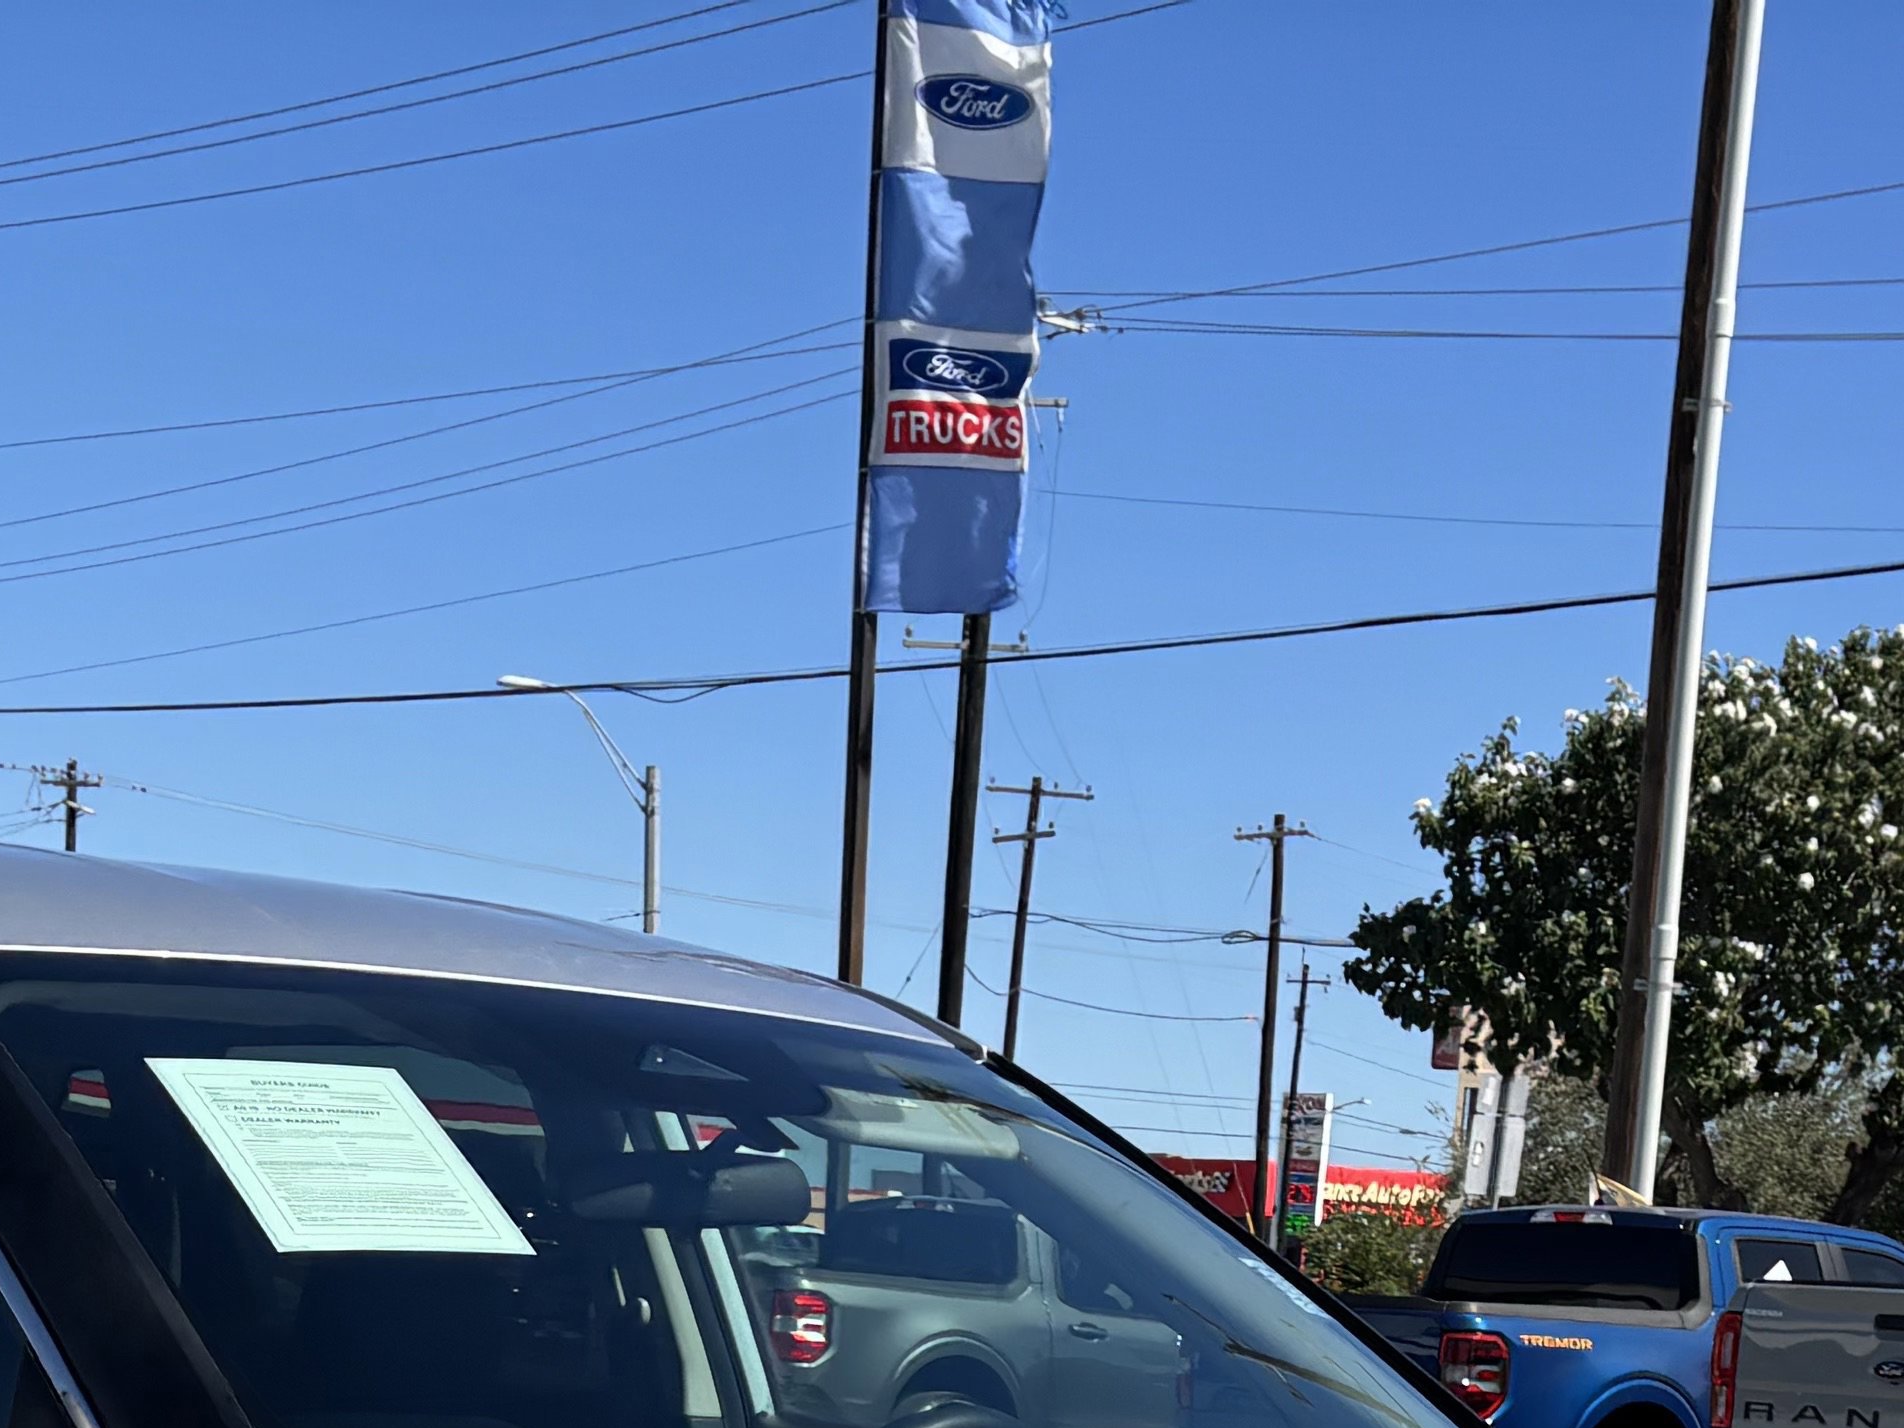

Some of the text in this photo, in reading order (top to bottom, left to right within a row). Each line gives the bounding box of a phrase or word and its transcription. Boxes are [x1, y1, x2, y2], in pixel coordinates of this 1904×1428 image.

[941, 82, 1007, 119] Ford
[926, 353, 988, 386] Ford
[892, 410, 1022, 450] TRUCKS
[1519, 1334, 1594, 1351] TREMOR
